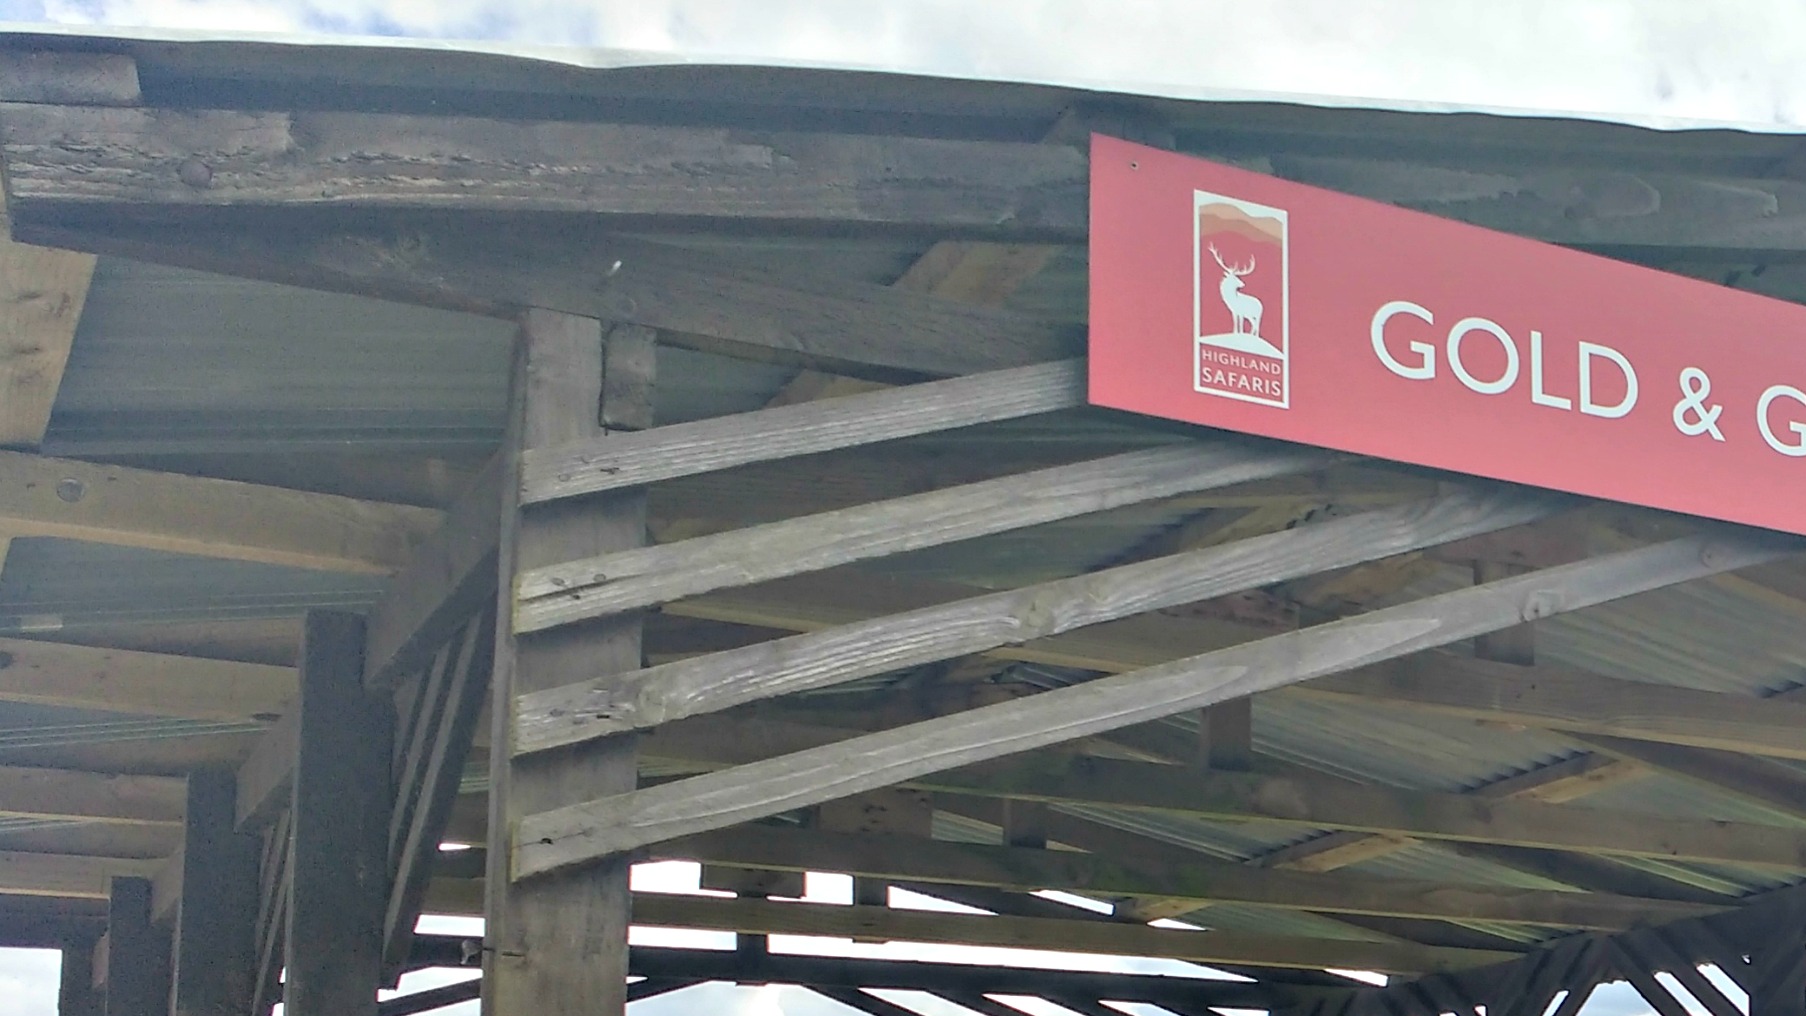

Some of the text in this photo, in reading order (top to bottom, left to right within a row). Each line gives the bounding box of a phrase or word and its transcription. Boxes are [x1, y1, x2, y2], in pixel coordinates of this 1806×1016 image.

[1202, 349, 1281, 375] HIGHLAND
[1370, 300, 1639, 418] GOLD
[1672, 367, 1726, 442] &
[1202, 367, 1281, 397] SAFARIS
